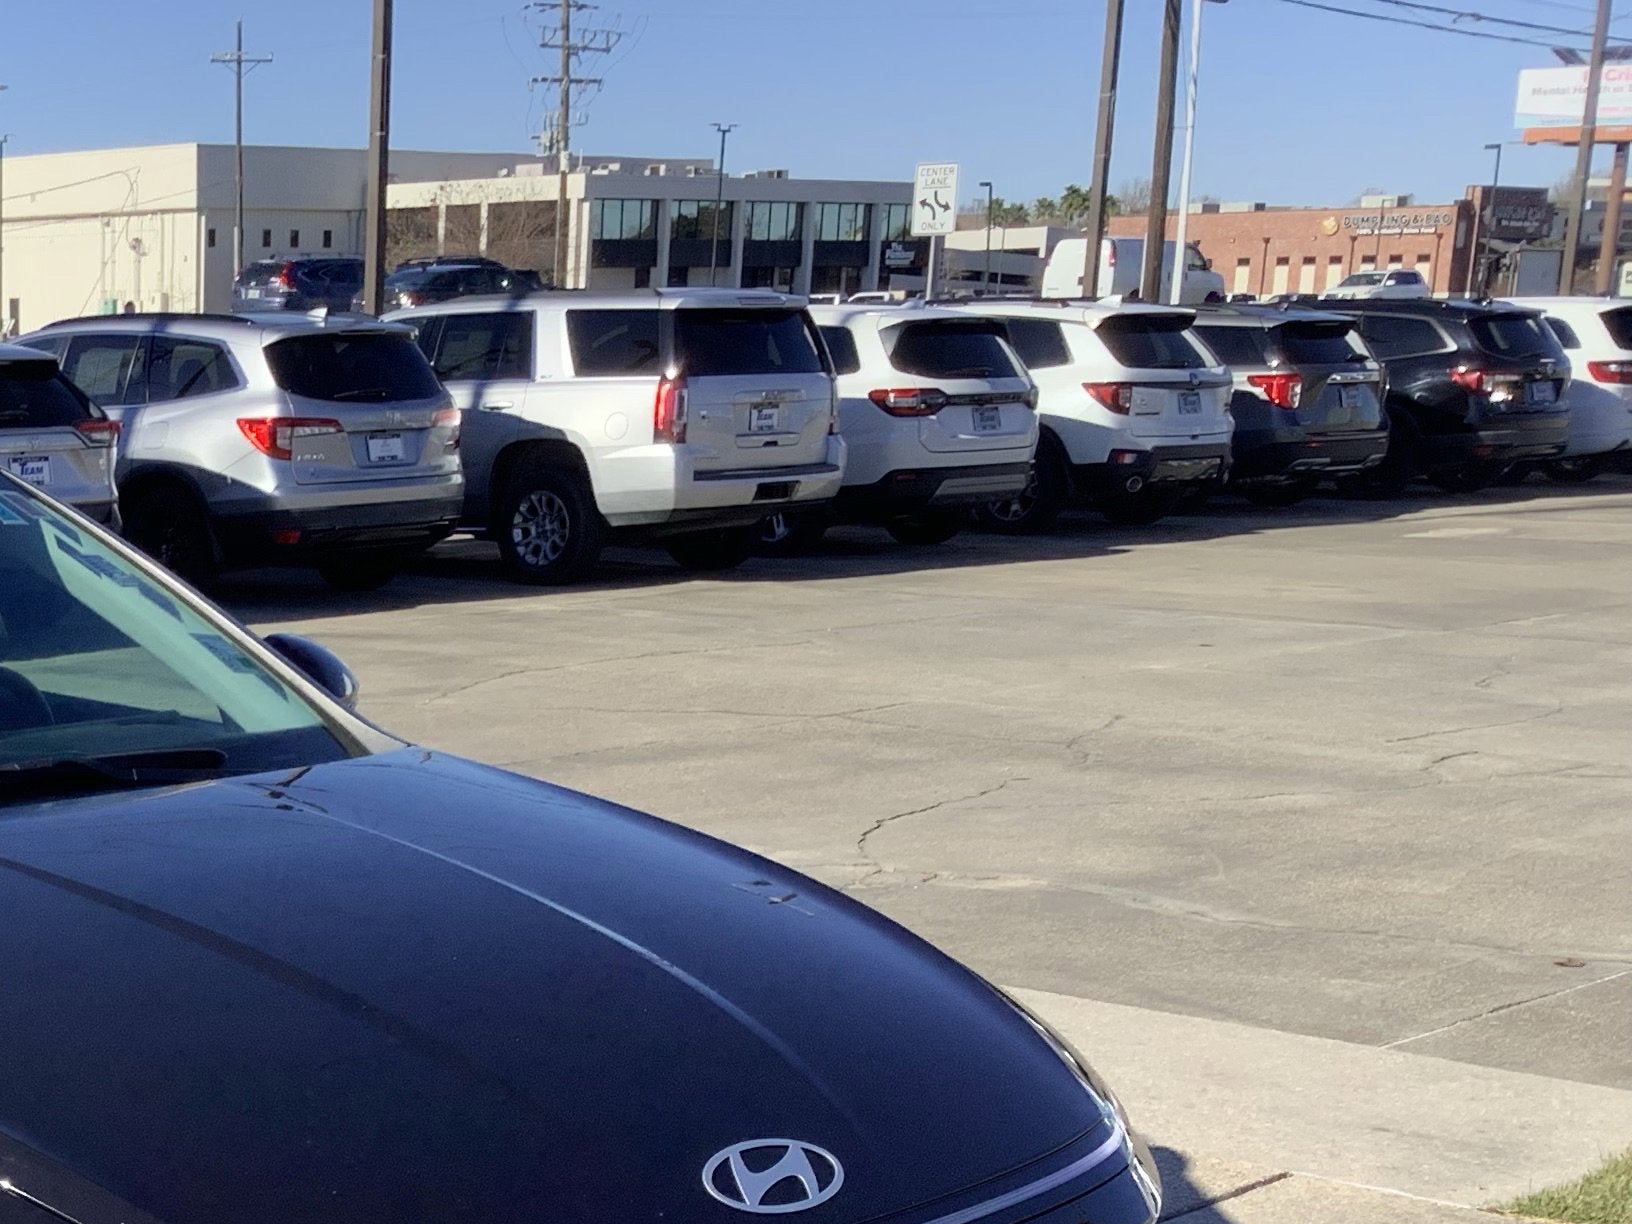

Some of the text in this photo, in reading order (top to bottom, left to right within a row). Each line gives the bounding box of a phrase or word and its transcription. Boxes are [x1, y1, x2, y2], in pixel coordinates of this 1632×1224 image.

[920, 167, 955, 177] CENTER
[925, 177, 948, 187] LANE
[920, 222, 945, 231] ONLY
[19, 462, 44, 475] TEAM
